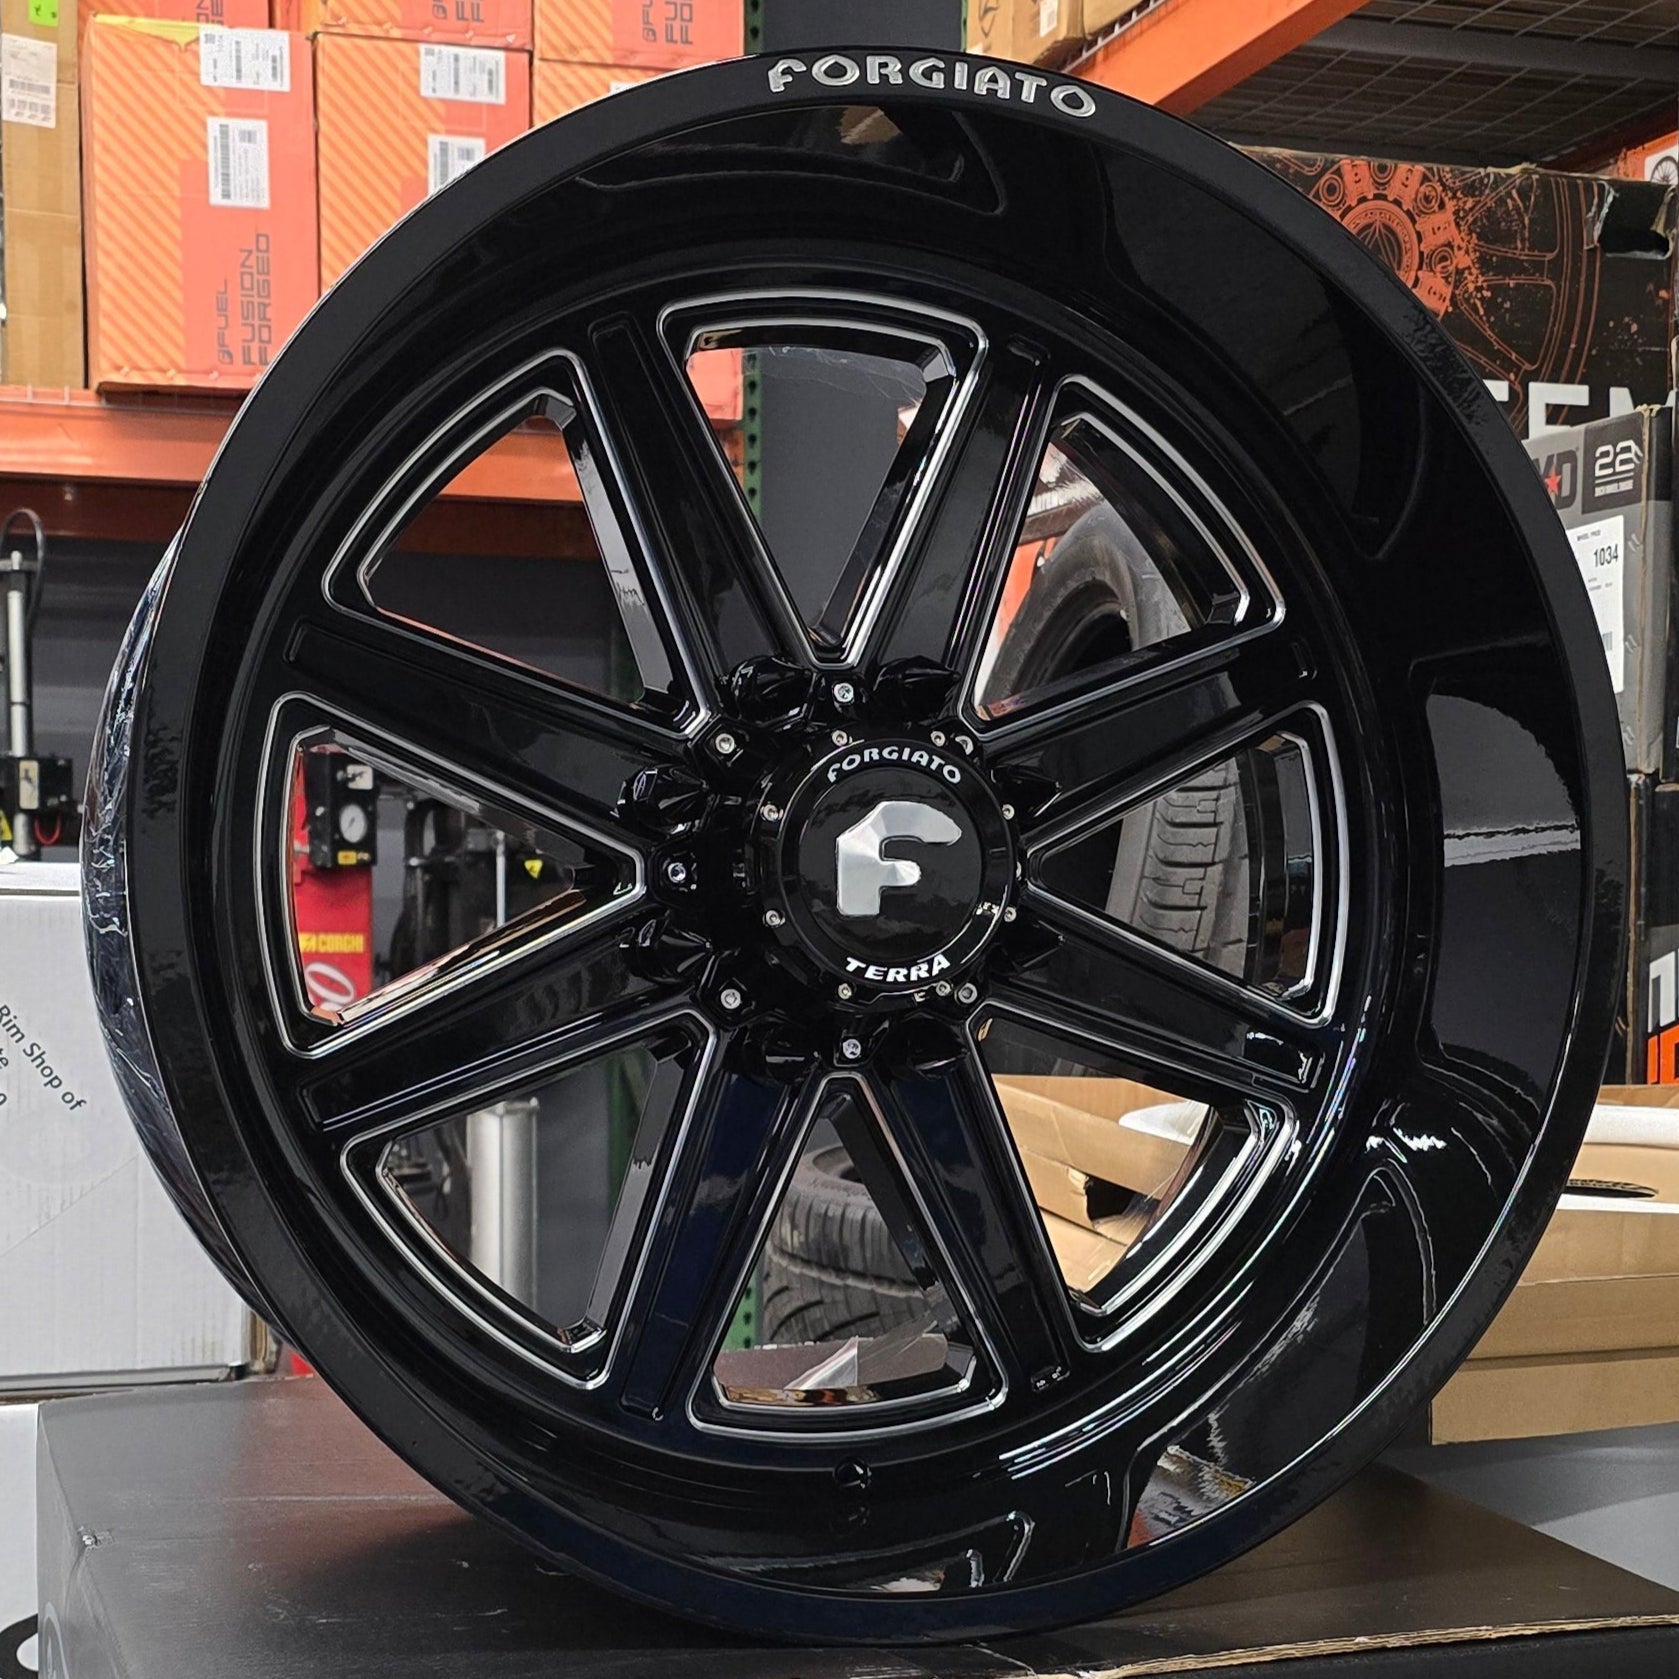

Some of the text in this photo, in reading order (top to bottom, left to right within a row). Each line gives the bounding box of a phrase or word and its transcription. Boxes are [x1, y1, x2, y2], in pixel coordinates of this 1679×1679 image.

[767, 54, 1097, 118] FORGIATO
[215, 279, 230, 349] FUEL
[240, 248, 257, 366] FUSION
[255, 233, 272, 366] FORGED
[1593, 543, 1619, 568] 1034
[826, 746, 962, 784] FORGIATO
[844, 953, 951, 983] TERRA
[0, 1004, 87, 1111] Rim Shop of
